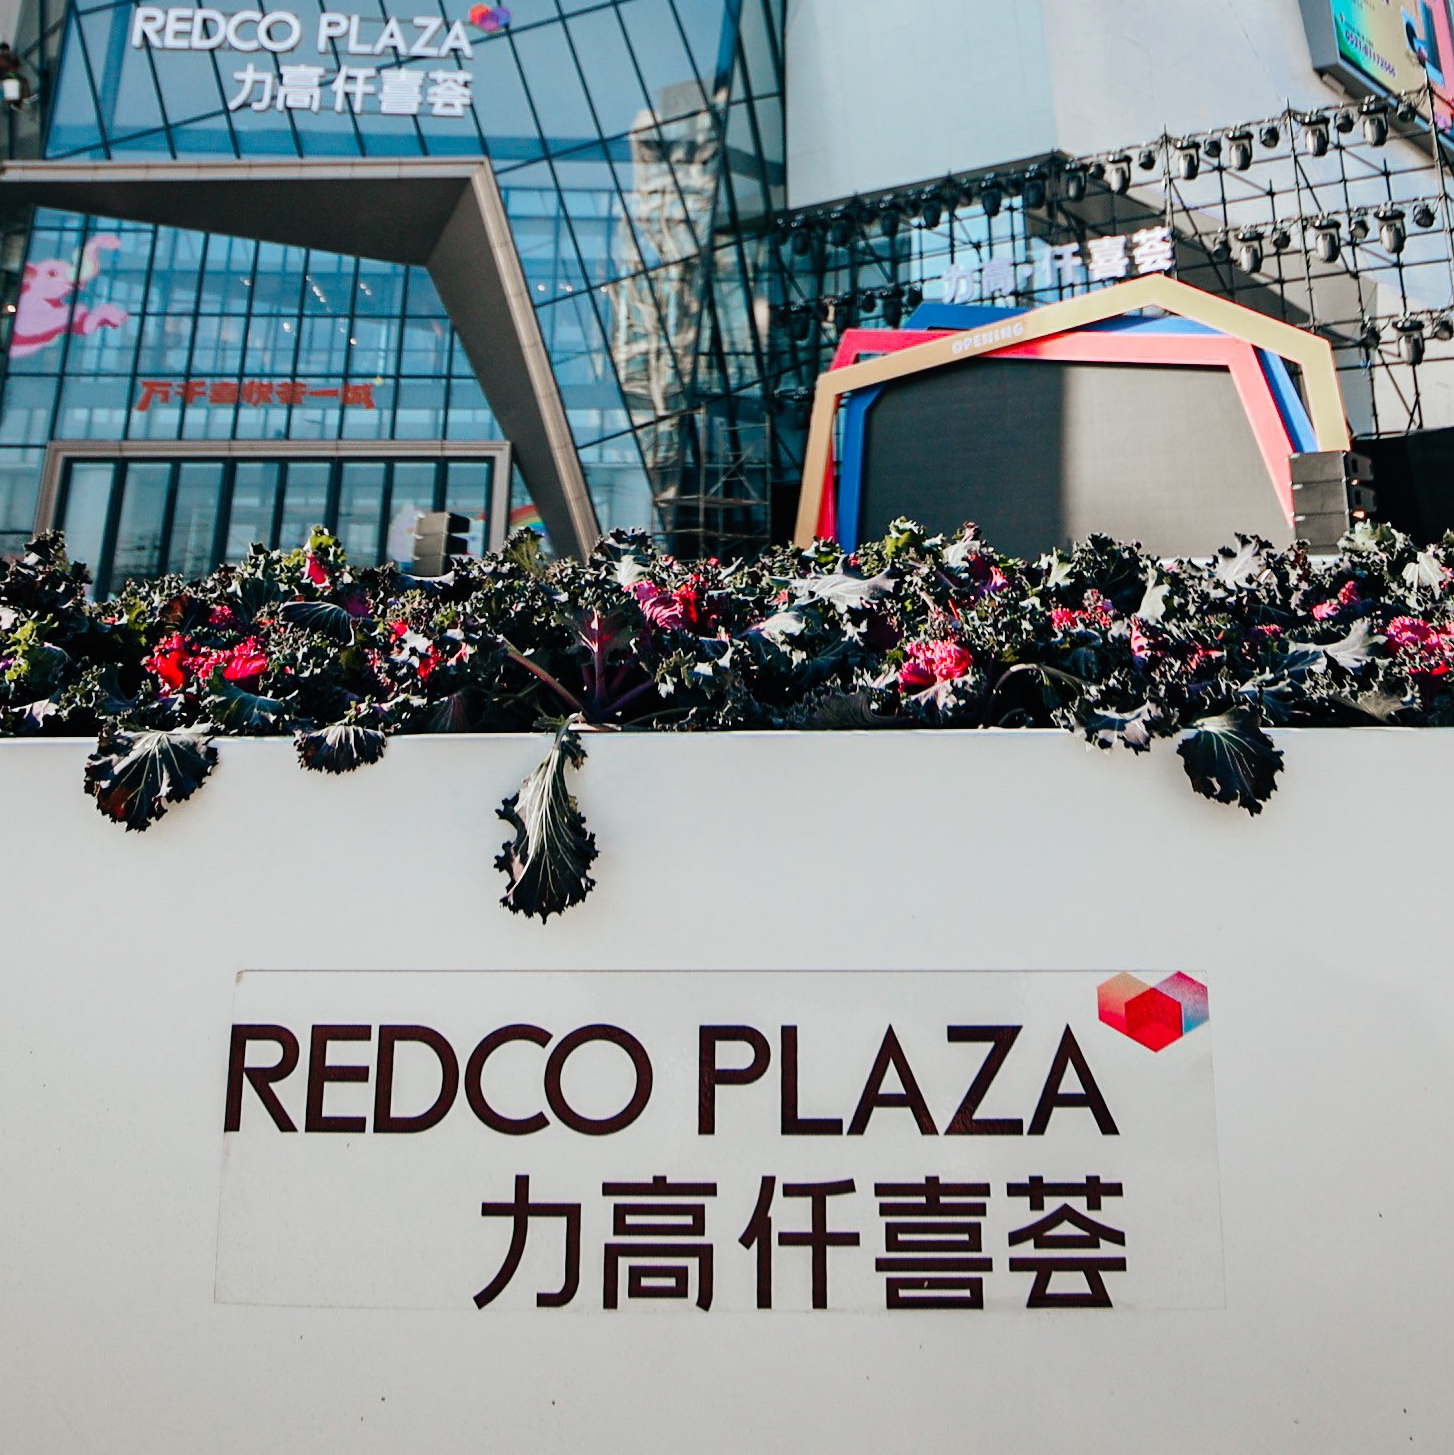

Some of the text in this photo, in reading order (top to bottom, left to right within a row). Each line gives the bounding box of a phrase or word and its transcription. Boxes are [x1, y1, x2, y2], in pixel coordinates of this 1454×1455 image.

[131, 6, 474, 59] REDCO PLAZA
[229, 63, 473, 117] 力高仟喜荟
[951, 322, 1024, 355] OPENING
[224, 1023, 1121, 1137] REDCO PLAZA
[473, 1174, 1128, 1312] 力高仟喜荟
